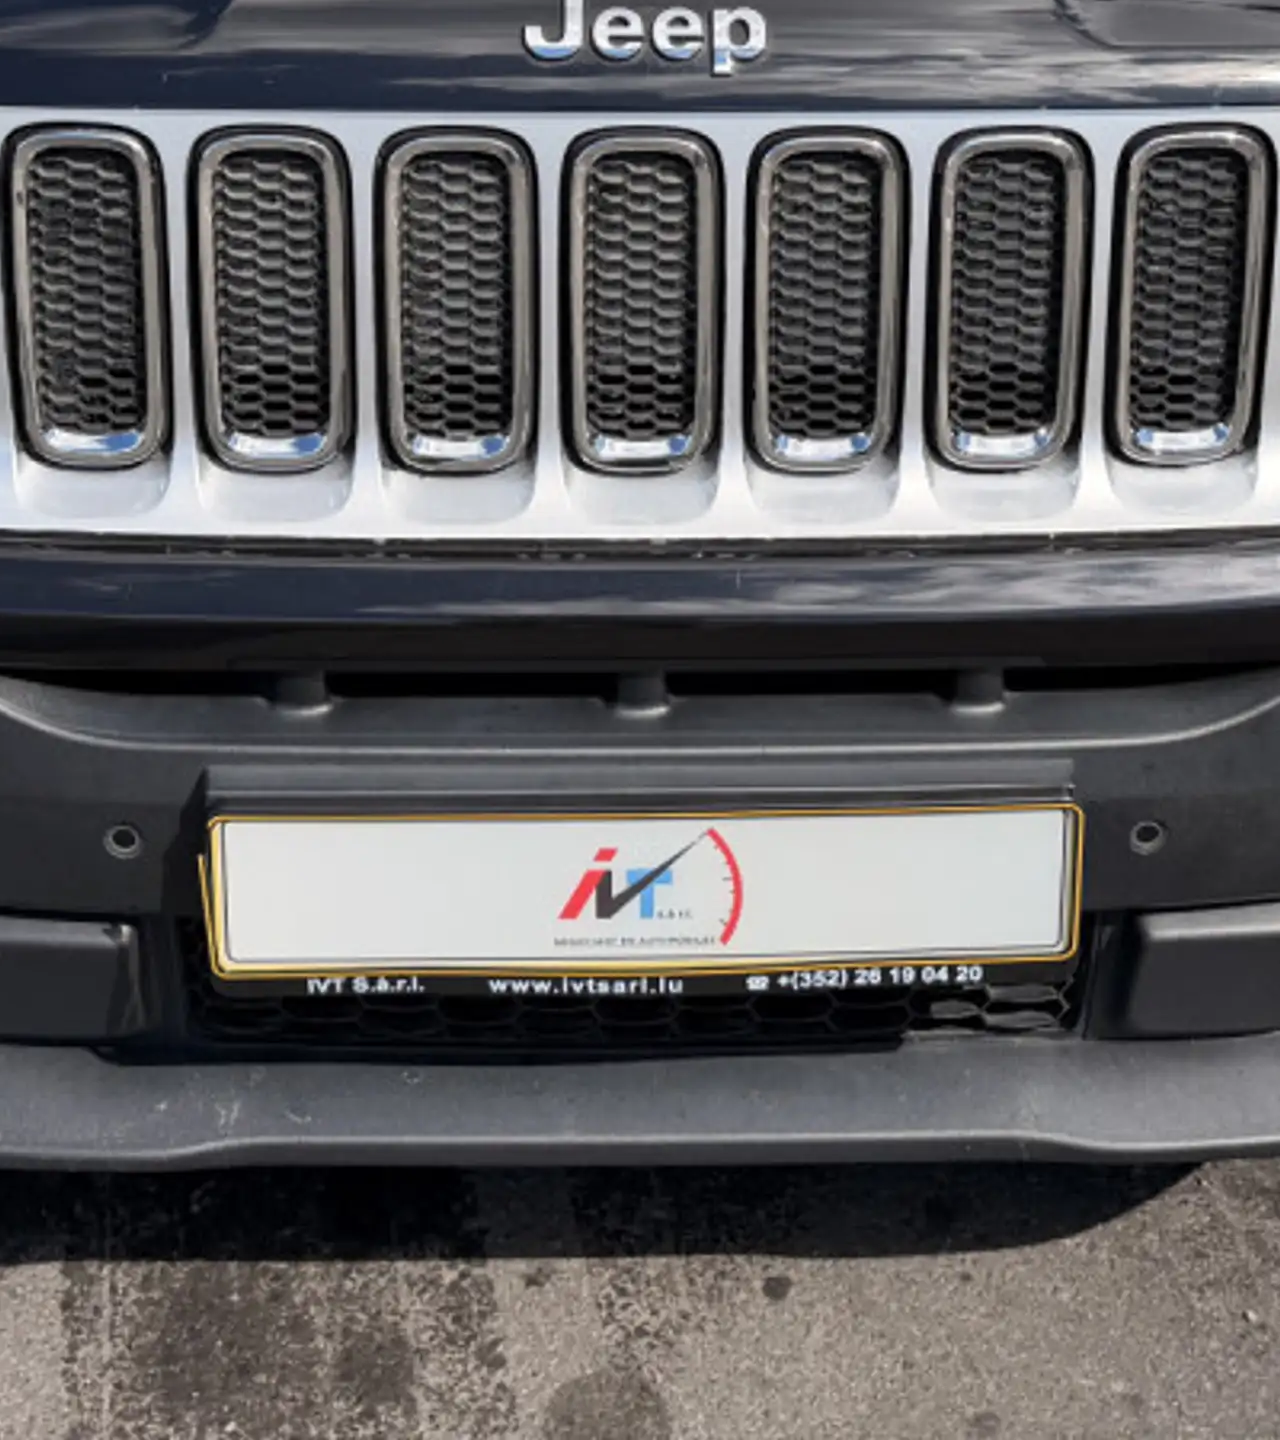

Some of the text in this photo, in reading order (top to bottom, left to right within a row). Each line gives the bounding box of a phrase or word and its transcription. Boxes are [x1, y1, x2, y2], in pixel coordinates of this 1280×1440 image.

[306, 976, 346, 995] IVT
[777, 969, 848, 991] +(352)
[889, 966, 916, 986] 19
[921, 965, 949, 985] 04
[956, 964, 983, 983] 20
